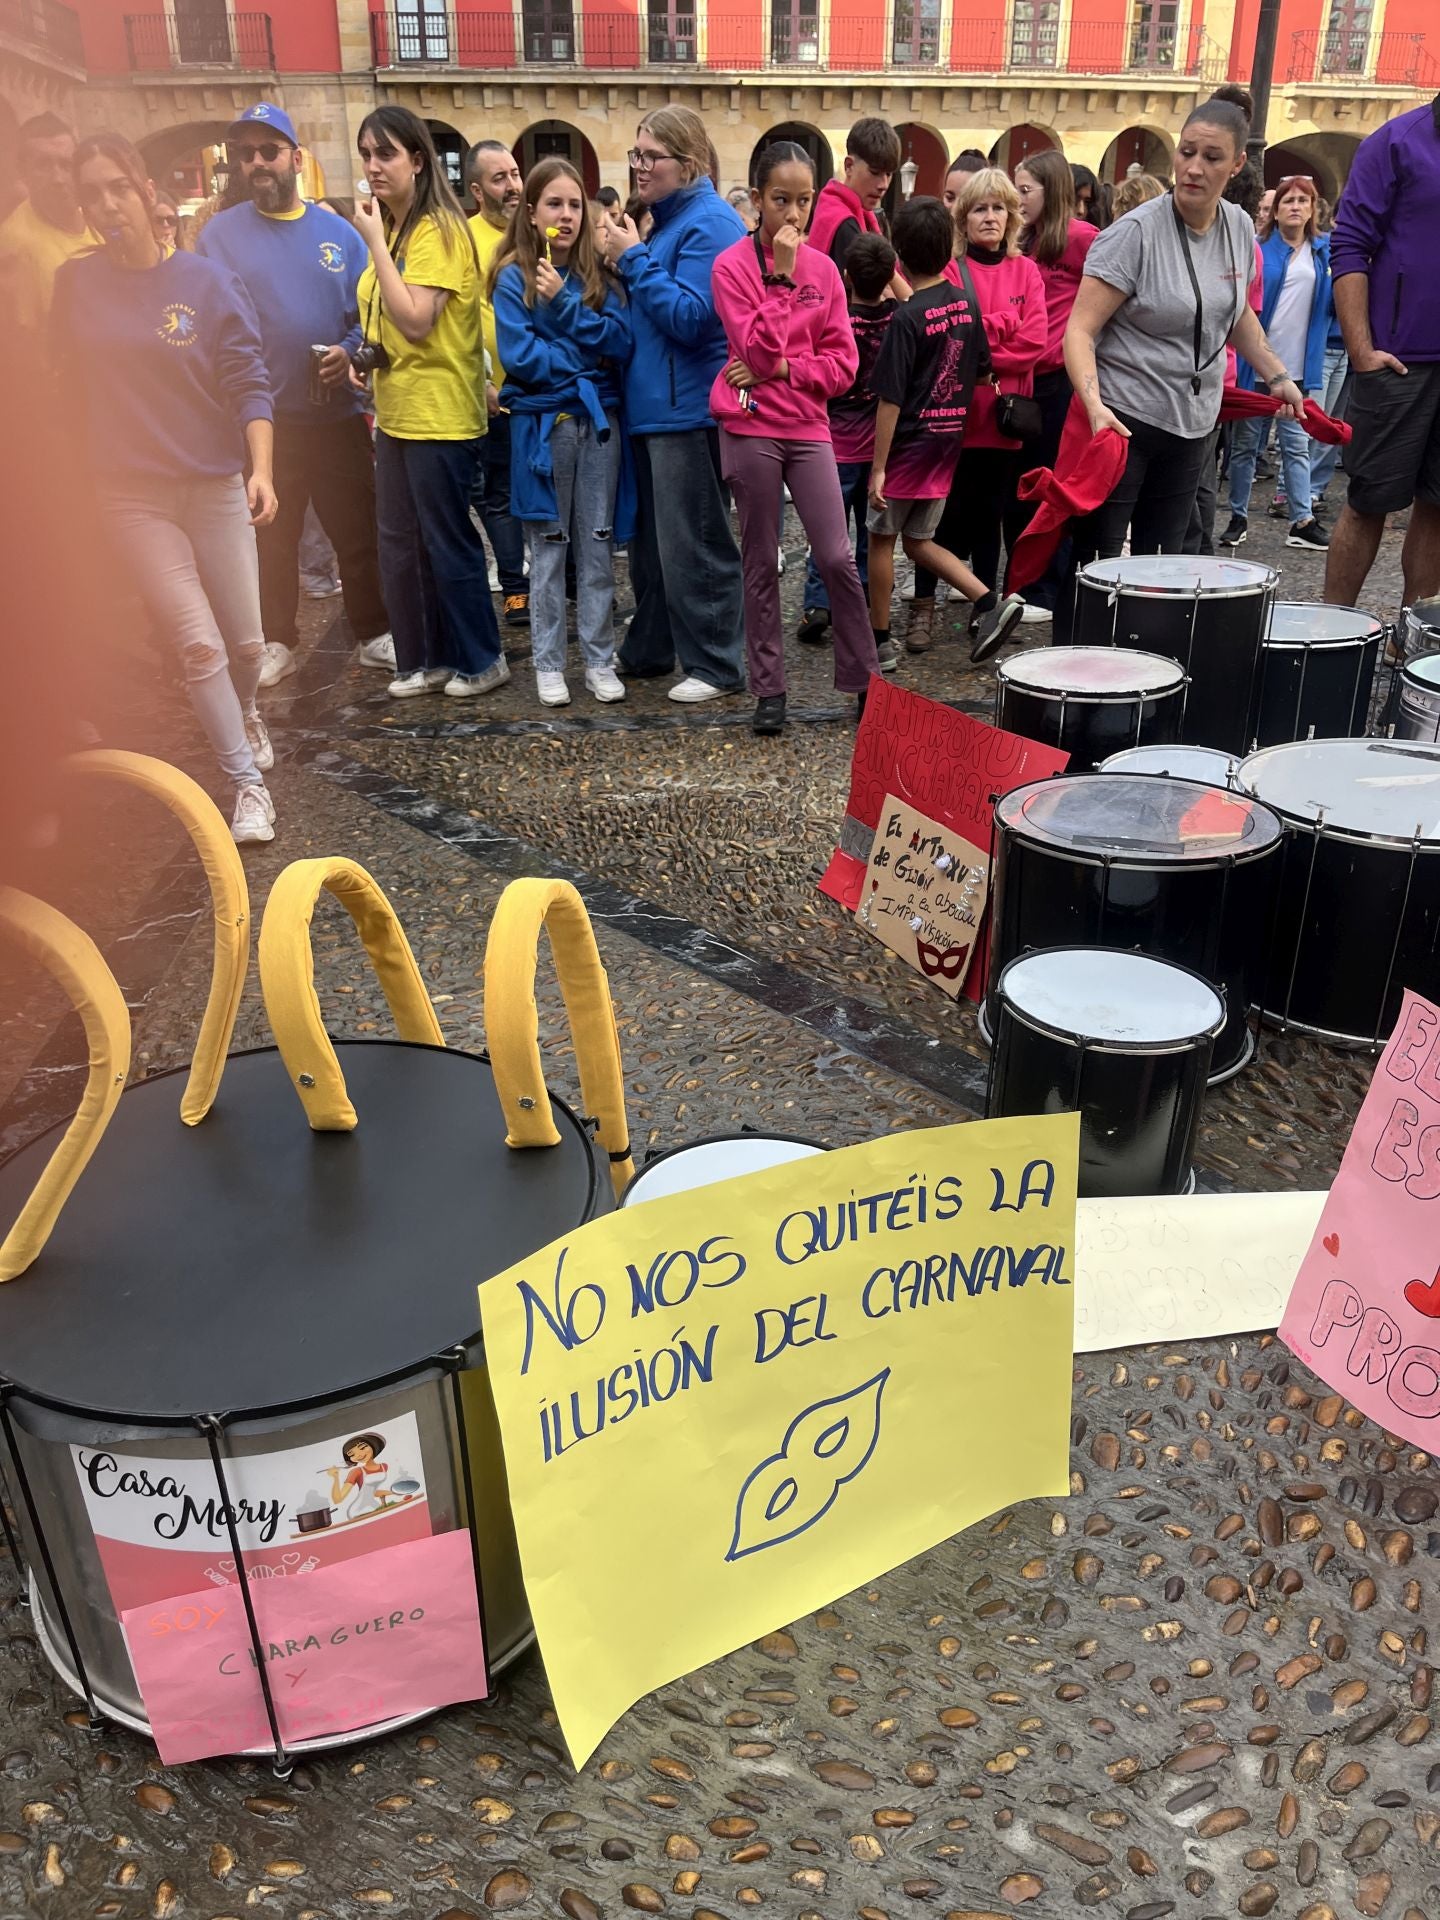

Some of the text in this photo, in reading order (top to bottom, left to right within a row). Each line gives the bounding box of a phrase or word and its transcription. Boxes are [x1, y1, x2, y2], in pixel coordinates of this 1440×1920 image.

[854, 724, 899, 781] SIN
[866, 678, 1024, 778] ANTROXU
[874, 846, 890, 867] de
[515, 1159, 1056, 1375] NO NOS QUITÉIS LA
[539, 1326, 717, 1464] ILUSIÓN
[754, 1293, 838, 1364] DEL
[862, 1244, 1072, 1319] CARNAVAL
[79, 1450, 186, 1498] Casa
[153, 1494, 286, 1543] Mary
[150, 1606, 227, 1637] SOY
[285, 1668, 308, 1688] Y
